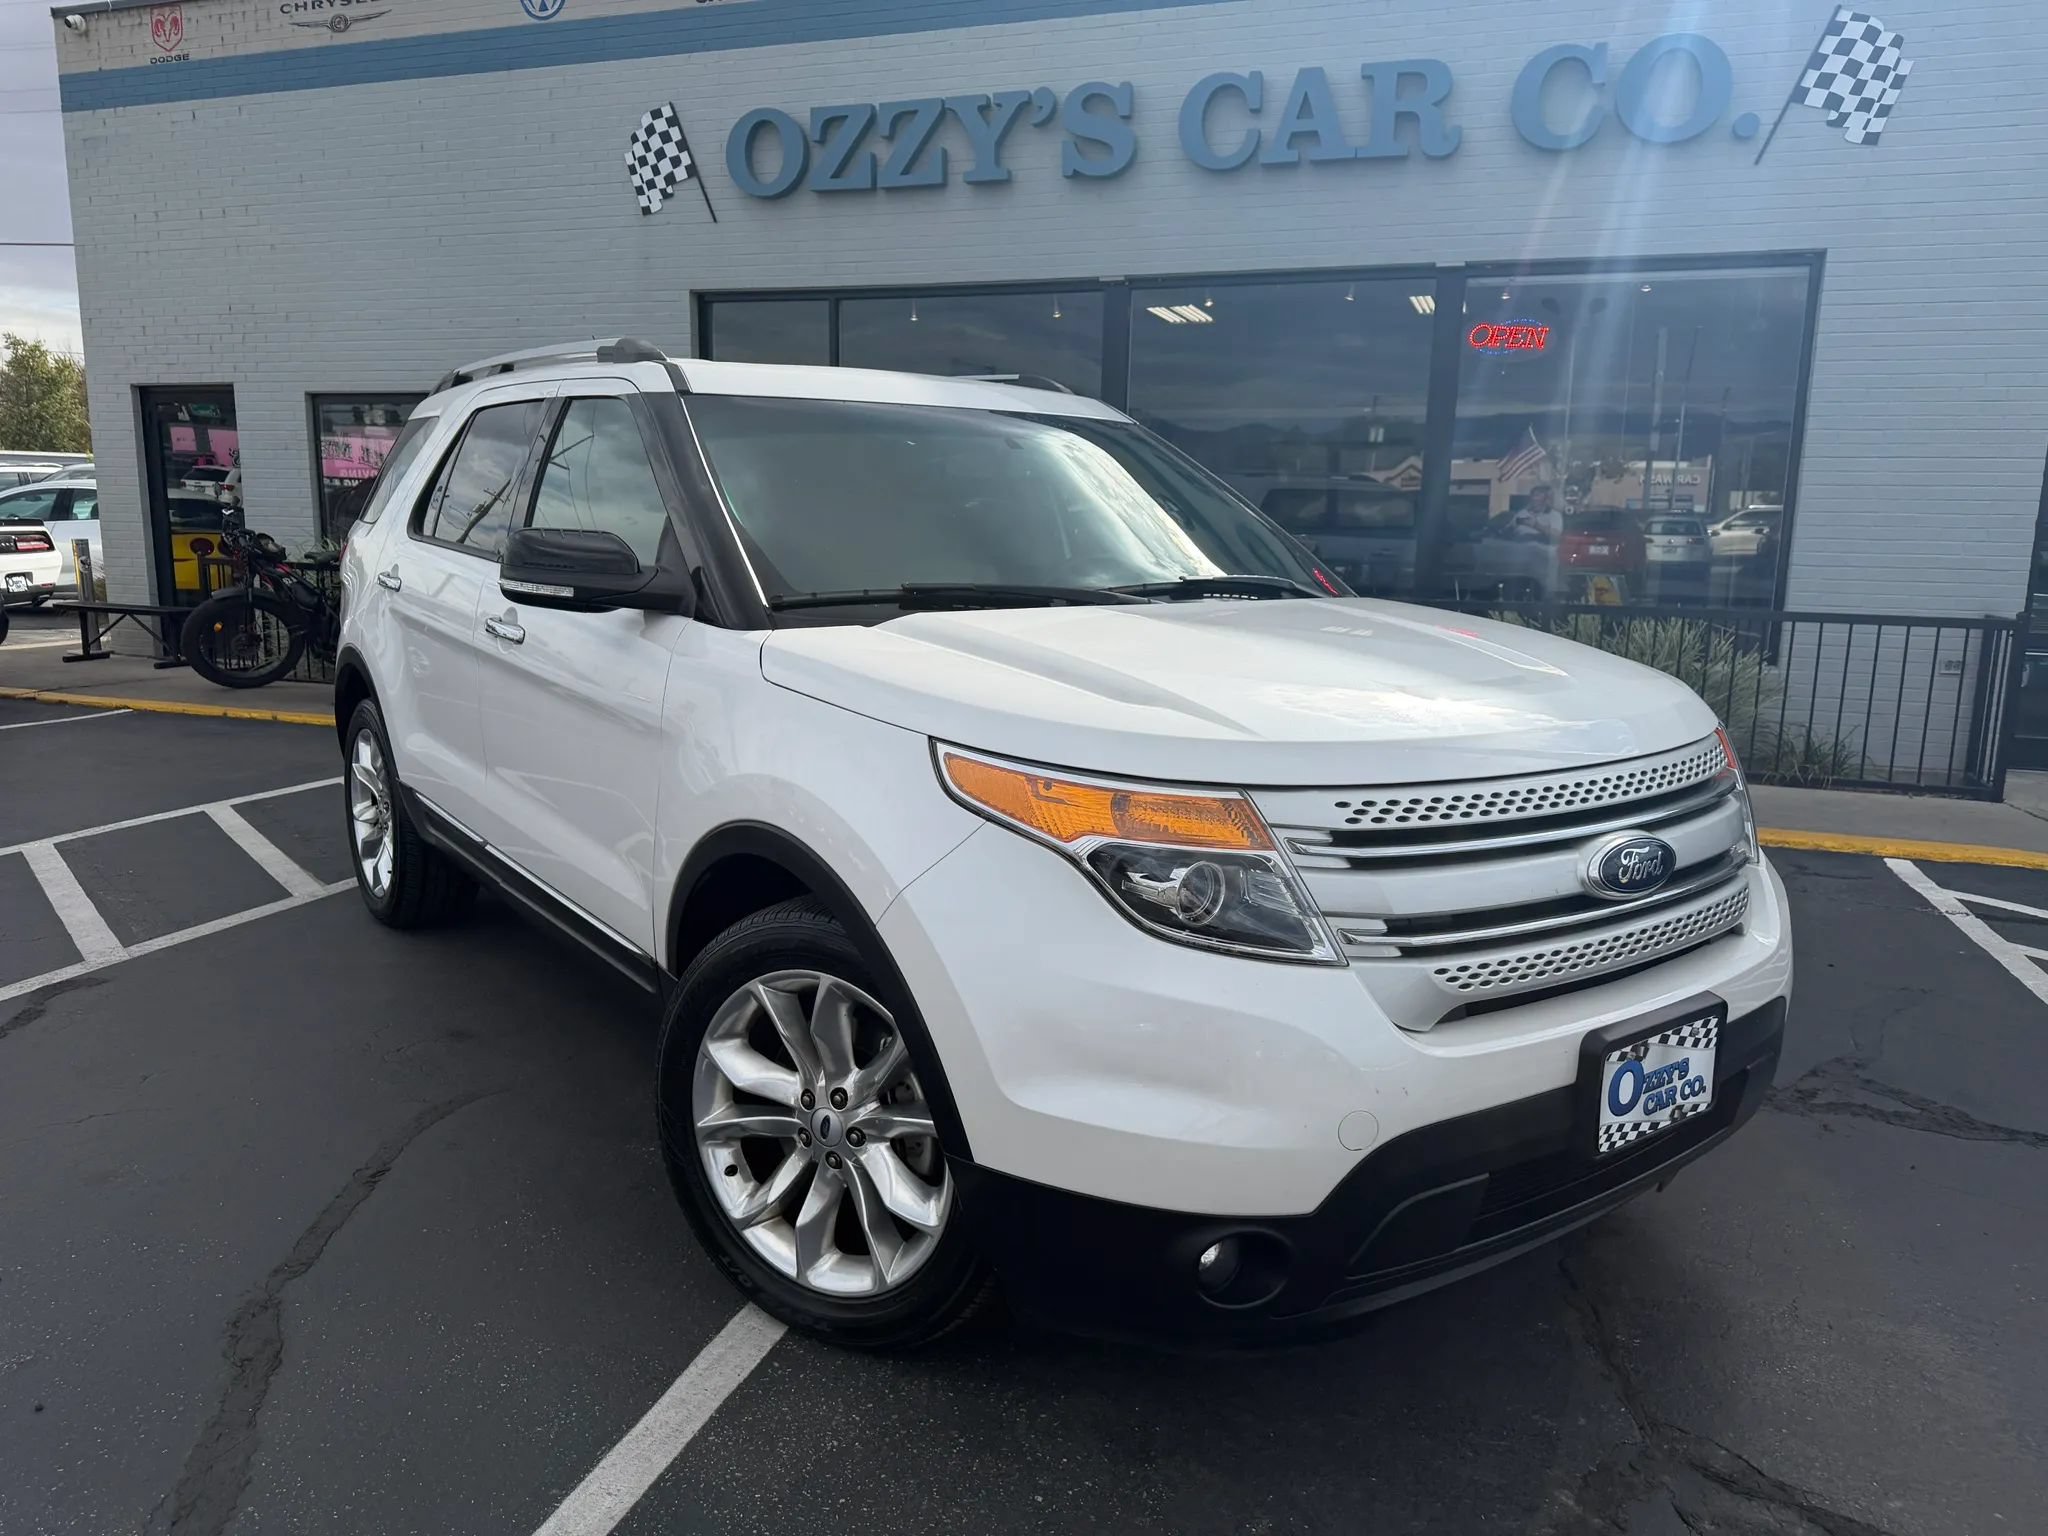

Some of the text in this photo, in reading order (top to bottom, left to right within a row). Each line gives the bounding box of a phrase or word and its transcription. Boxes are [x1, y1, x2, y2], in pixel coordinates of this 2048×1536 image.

[150, 53, 190, 65] DODGE
[726, 32, 1761, 199] OZZY'S CAR CO.
[1469, 322, 1549, 351] OPEN
[1618, 846, 1663, 883] Ford
[1608, 1057, 1690, 1117] OZZY'S
[1642, 1075, 1707, 1116] CAR CO.
